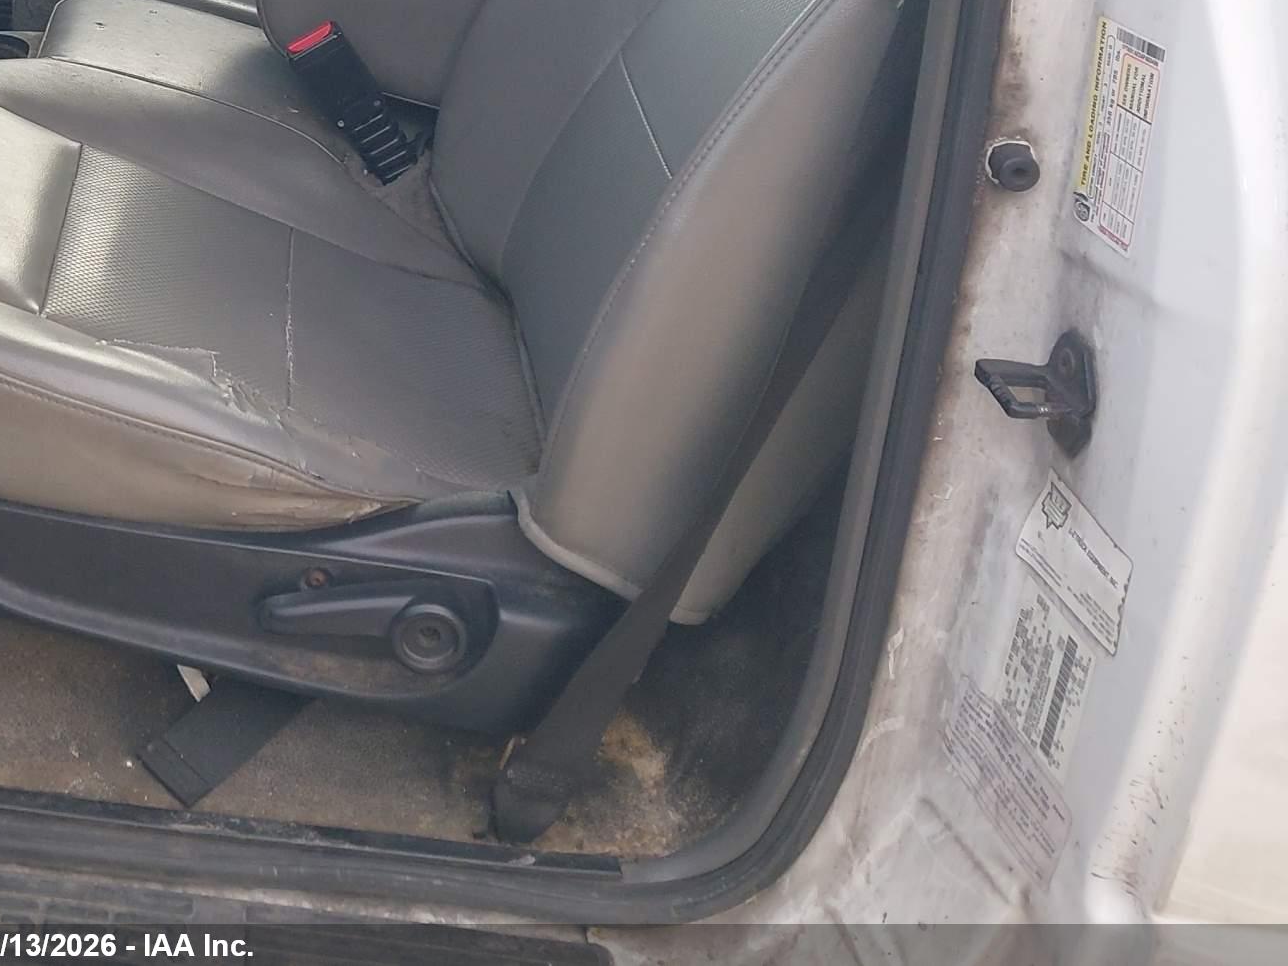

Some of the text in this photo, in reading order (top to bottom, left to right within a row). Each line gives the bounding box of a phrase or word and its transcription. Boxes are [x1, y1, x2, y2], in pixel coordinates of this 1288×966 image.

[1081, 163, 1089, 186] TIRE
[1088, 94, 1098, 139] LOADING
[1094, 21, 1107, 92] INFORMATION
